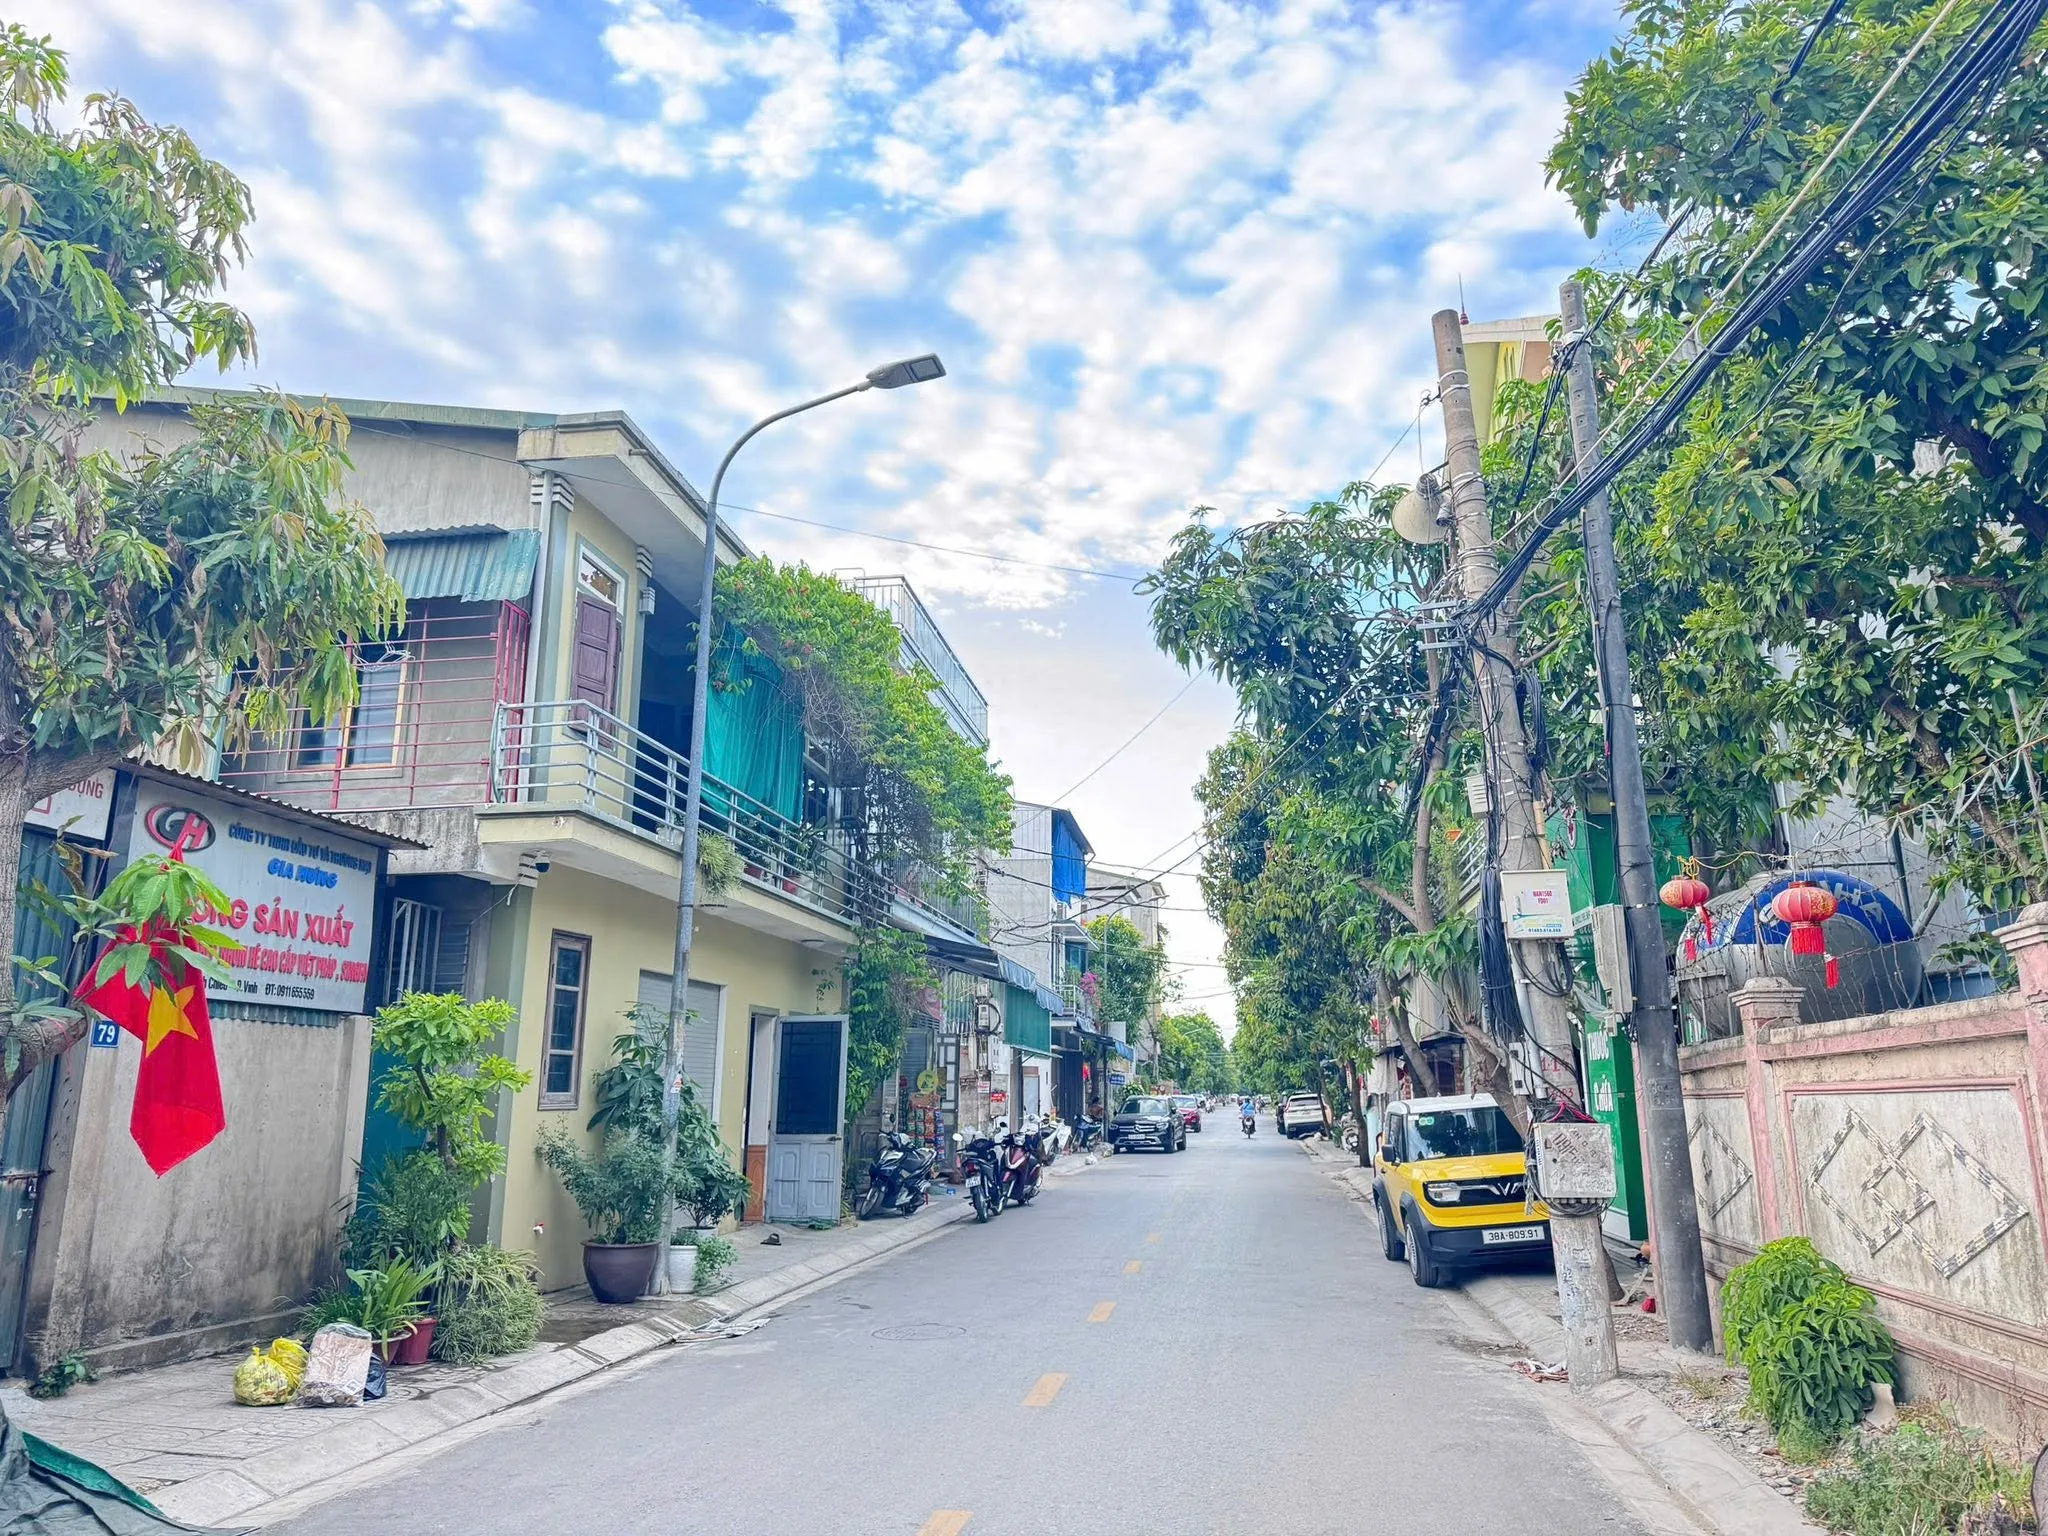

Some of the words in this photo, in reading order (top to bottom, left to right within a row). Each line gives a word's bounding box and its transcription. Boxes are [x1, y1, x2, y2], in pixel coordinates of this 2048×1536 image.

[253, 895, 300, 939] SẢN
[302, 903, 354, 948] XUẤT
[98, 1024, 116, 1043] 79
